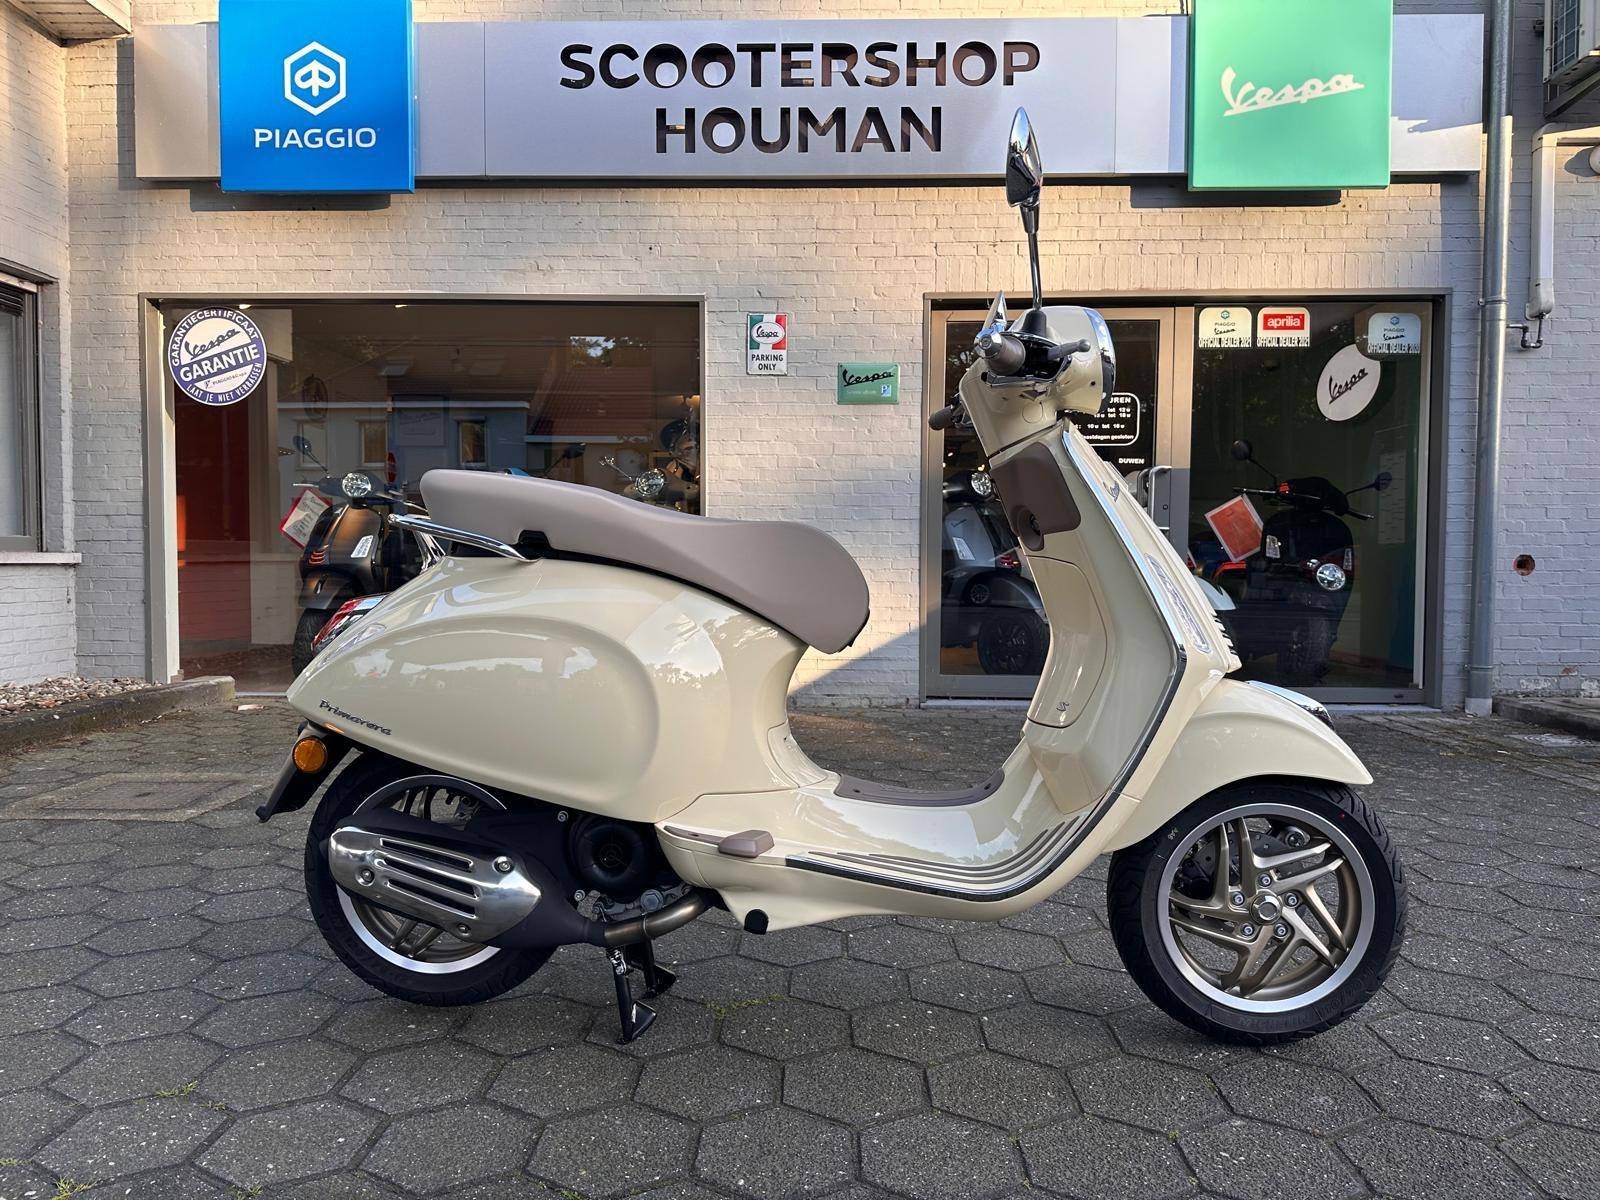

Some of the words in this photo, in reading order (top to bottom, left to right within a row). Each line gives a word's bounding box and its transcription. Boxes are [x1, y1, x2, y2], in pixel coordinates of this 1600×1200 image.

[560, 41, 1041, 89] SCOOTERSHOP
[1221, 66, 1365, 117] Vespa
[254, 127, 377, 148] PIAGGIO
[655, 106, 942, 154] HOUMAN
[172, 310, 259, 366] GARANTIECERTIFICAAT
[755, 325, 780, 338] Vespa
[1267, 315, 1301, 329] aprilia
[184, 328, 241, 360] Vespa
[751, 353, 784, 362] PARKING
[180, 344, 260, 381] GARANTIE
[757, 362, 777, 371] ONLY
[842, 368, 895, 388] Vespa
[186, 384, 204, 398] LAAT
[205, 393, 214, 403] JE
[218, 392, 234, 402] NIET
[235, 362, 262, 397] VERRASSEN
[1328, 367, 1369, 405] Vespa
[1118, 457, 1145, 465] DUWEN
[319, 699, 392, 736] Primavera
